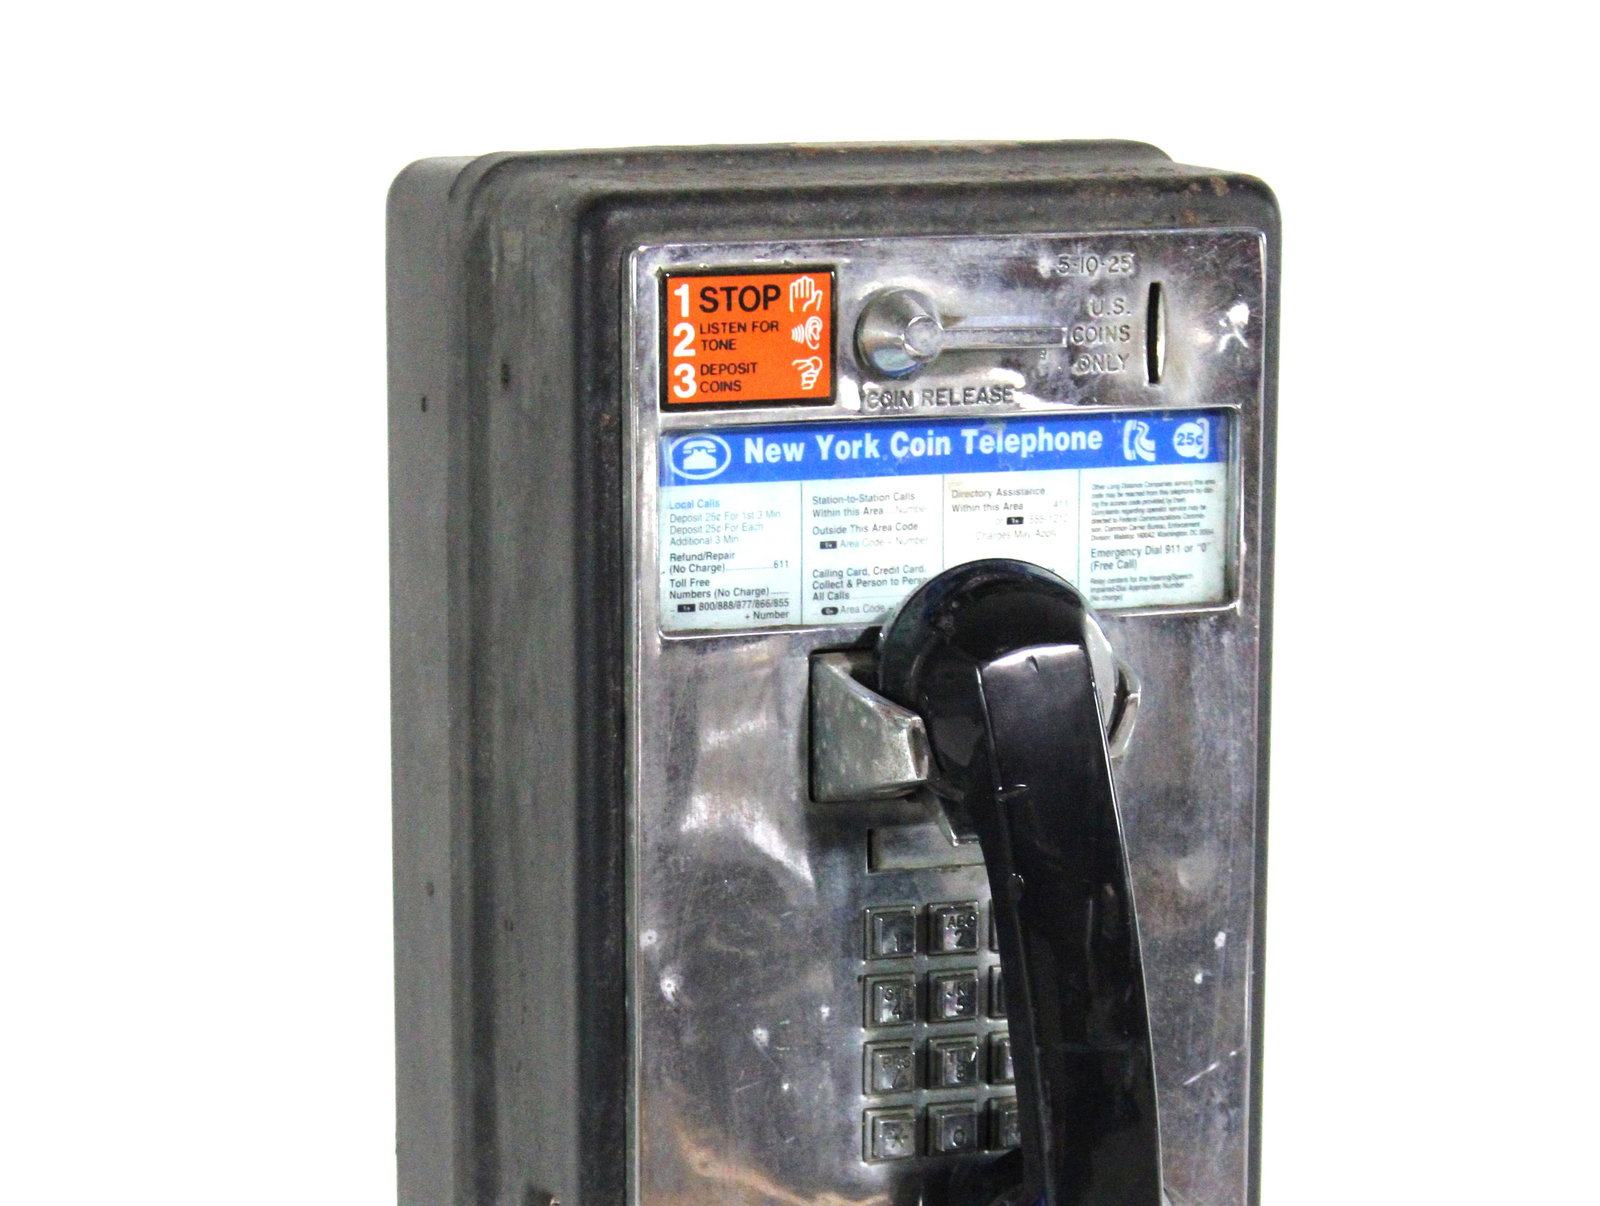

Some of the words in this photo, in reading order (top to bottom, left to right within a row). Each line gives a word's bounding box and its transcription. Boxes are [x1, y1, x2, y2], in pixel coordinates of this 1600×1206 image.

[674, 284, 689, 317] 1
[699, 284, 781, 313] STOP
[1089, 297, 1132, 317] U.S.
[673, 322, 696, 357] 2
[700, 321, 746, 334] LISTEN
[752, 320, 779, 332] FOR
[1072, 324, 1131, 345] COINS
[701, 339, 736, 351] TONE
[1076, 353, 1129, 373] ONLY
[673, 363, 697, 398] 3
[700, 362, 758, 376] DEPOSIT
[700, 380, 741, 392] COINS
[865, 390, 914, 410] COIN
[921, 384, 1015, 407] RELEASE
[744, 437, 805, 464] New
[816, 433, 879, 460] York
[890, 429, 950, 457] Coin
[961, 426, 1103, 459] Telephone
[812, 494, 890, 505] Station-to-Station
[893, 492, 915, 501] Calls
[952, 489, 992, 499] Directory
[996, 487, 1045, 496] Assistance
[669, 500, 694, 509] Local
[697, 499, 720, 508] Calls
[952, 504, 980, 512] Within
[983, 503, 999, 511] this
[1003, 502, 1023, 510] Area
[813, 509, 840, 518] Within
[844, 508, 860, 516] this
[863, 507, 883, 515] Area
[670, 514, 702, 524] Deposit
[670, 525, 702, 535] Deposit
[813, 526, 847, 535] Outside
[850, 525, 868, 533] This
[872, 524, 892, 532] Area
[895, 522, 918, 531] Code
[670, 537, 712, 546] Additional
[670, 552, 735, 562] Refund/Repair
[1091, 547, 1141, 559] Emergency
[1145, 545, 1162, 555] Dial
[1165, 545, 1180, 554] 911
[670, 565, 686, 575] (No
[1090, 560, 1114, 572] (Free
[1117, 559, 1137, 570] Call)
[813, 569, 843, 579] Calling
[873, 566, 900, 575] Credit
[670, 579, 686, 587] Toll
[690, 578, 710, 587] Free
[813, 580, 843, 590] Collect
[847, 580, 852, 588] &
[856, 579, 887, 587] Person
[670, 590, 711, 599] Numbers
[714, 588, 730, 598] (No
[813, 592, 824, 600] All
[827, 591, 850, 600] Calls
[840, 605, 860, 614] Area
[863, 604, 885, 613] Code
[753, 611, 789, 620] Number
